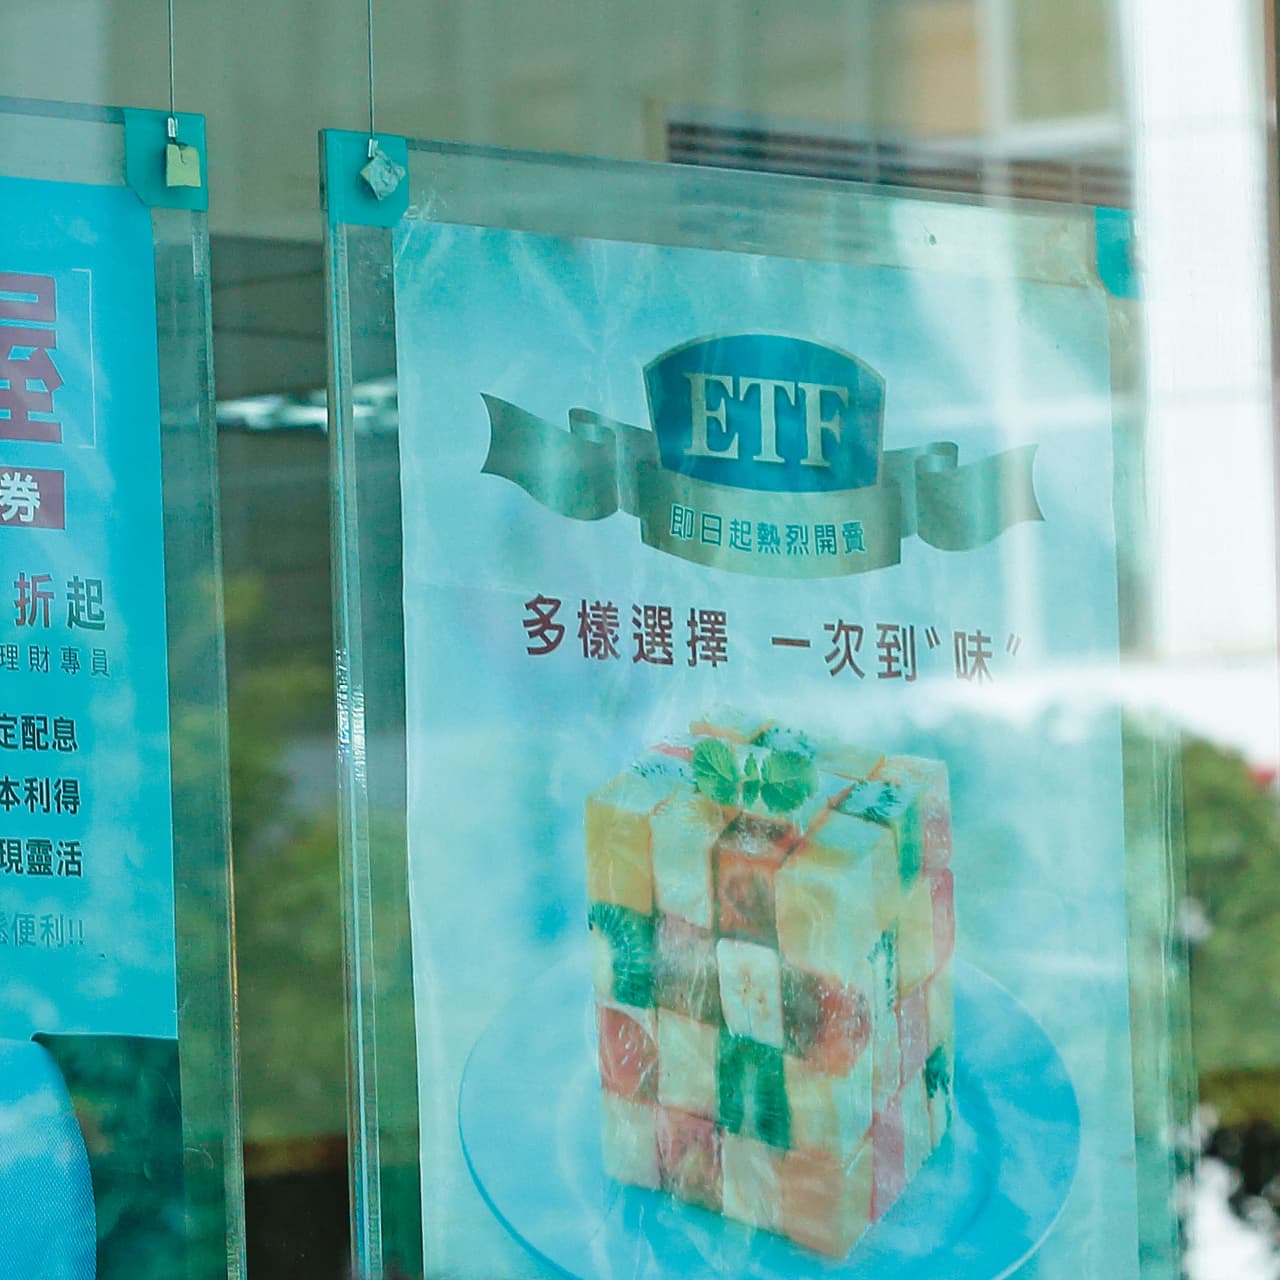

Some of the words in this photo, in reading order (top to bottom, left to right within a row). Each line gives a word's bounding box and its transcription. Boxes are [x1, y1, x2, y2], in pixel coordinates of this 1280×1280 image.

[683, 372, 849, 467] ETF
[670, 504, 866, 555] 即日起熱烈開賣
[522, 593, 728, 668] 多樣選擇
